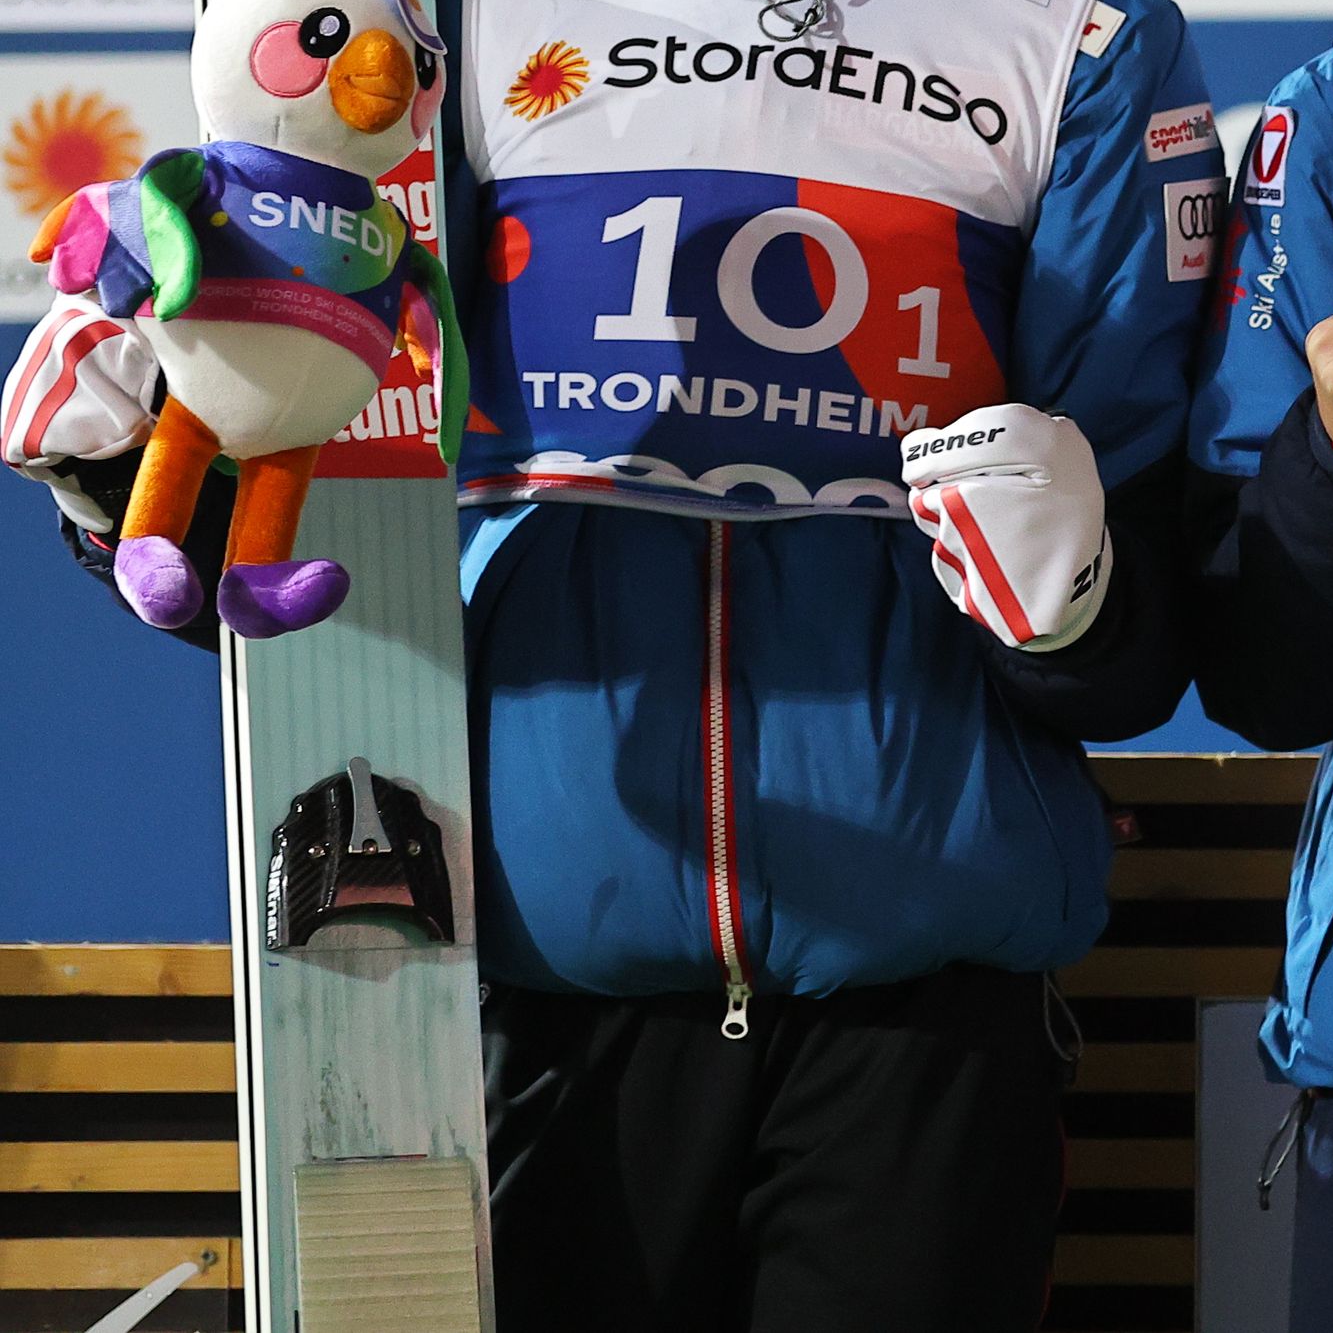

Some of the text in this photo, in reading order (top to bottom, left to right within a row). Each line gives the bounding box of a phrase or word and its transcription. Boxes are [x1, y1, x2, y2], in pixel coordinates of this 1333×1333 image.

[602, 35, 1009, 146] StoraEnso
[593, 195, 951, 379] 10 1
[521, 371, 930, 438] TRONDHEIM
[905, 426, 1006, 462] ziener
